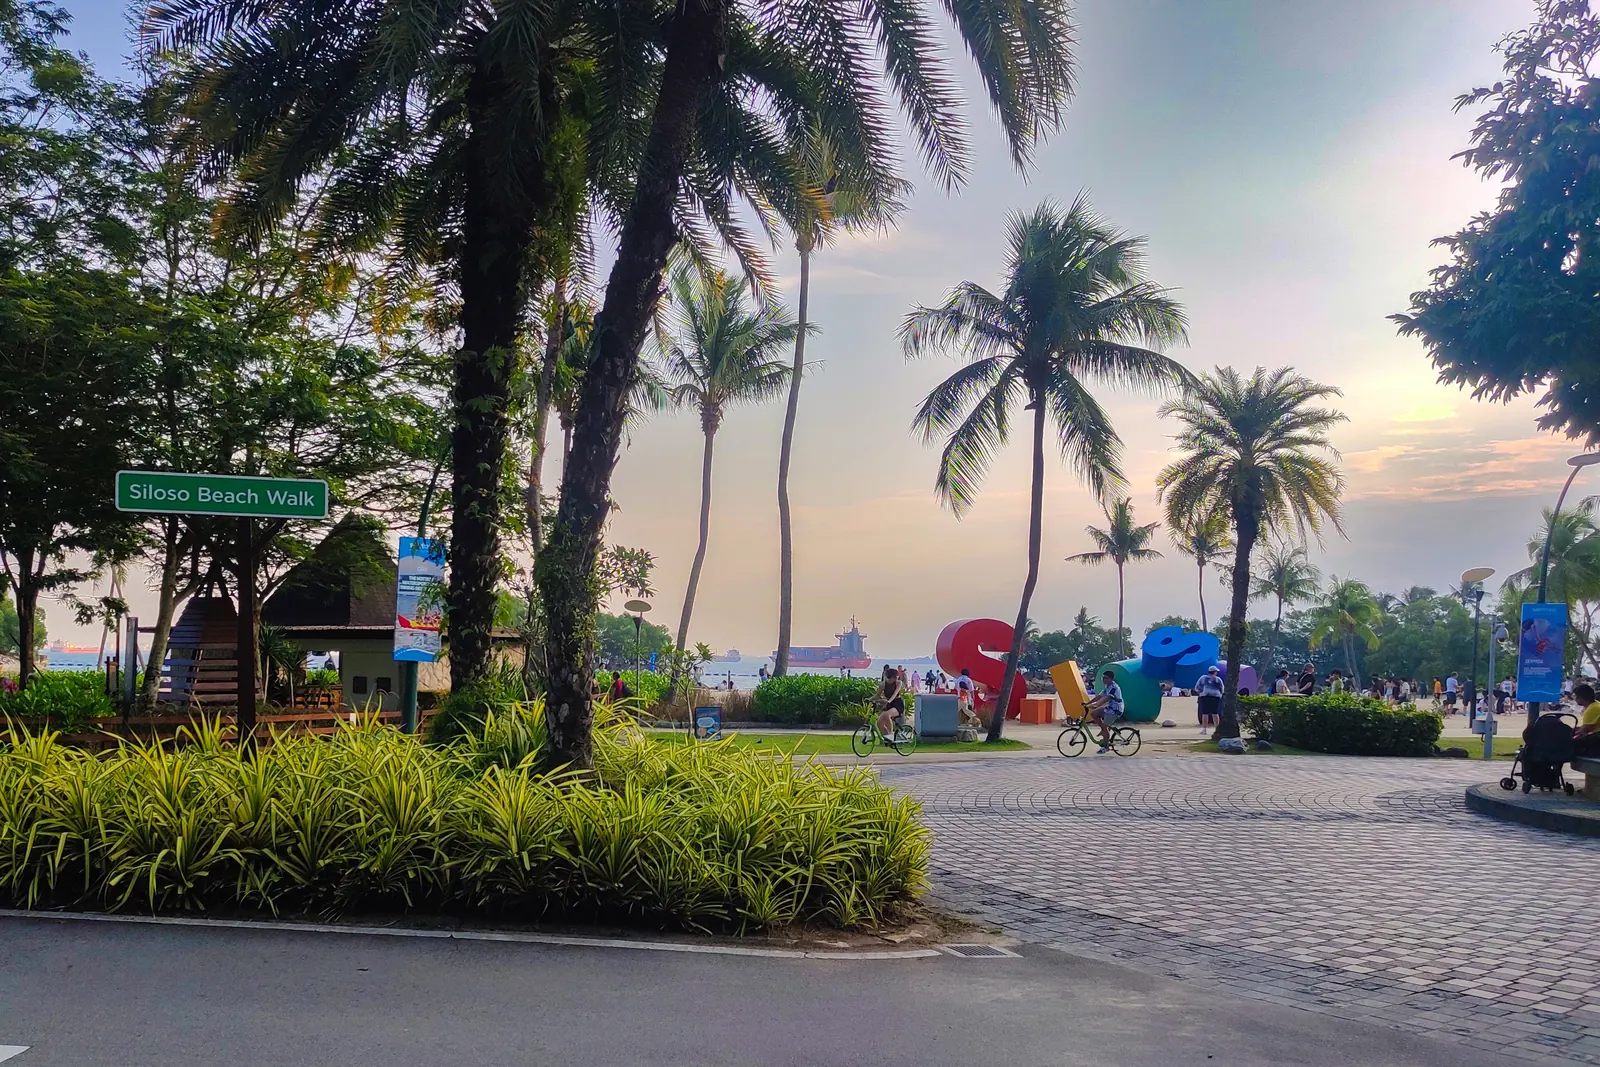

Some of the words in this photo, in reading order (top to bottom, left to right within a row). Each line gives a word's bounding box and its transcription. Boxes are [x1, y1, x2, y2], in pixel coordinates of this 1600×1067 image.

[129, 484, 190, 501] Siloso
[198, 487, 258, 504] Beach
[267, 489, 315, 507] Walk
